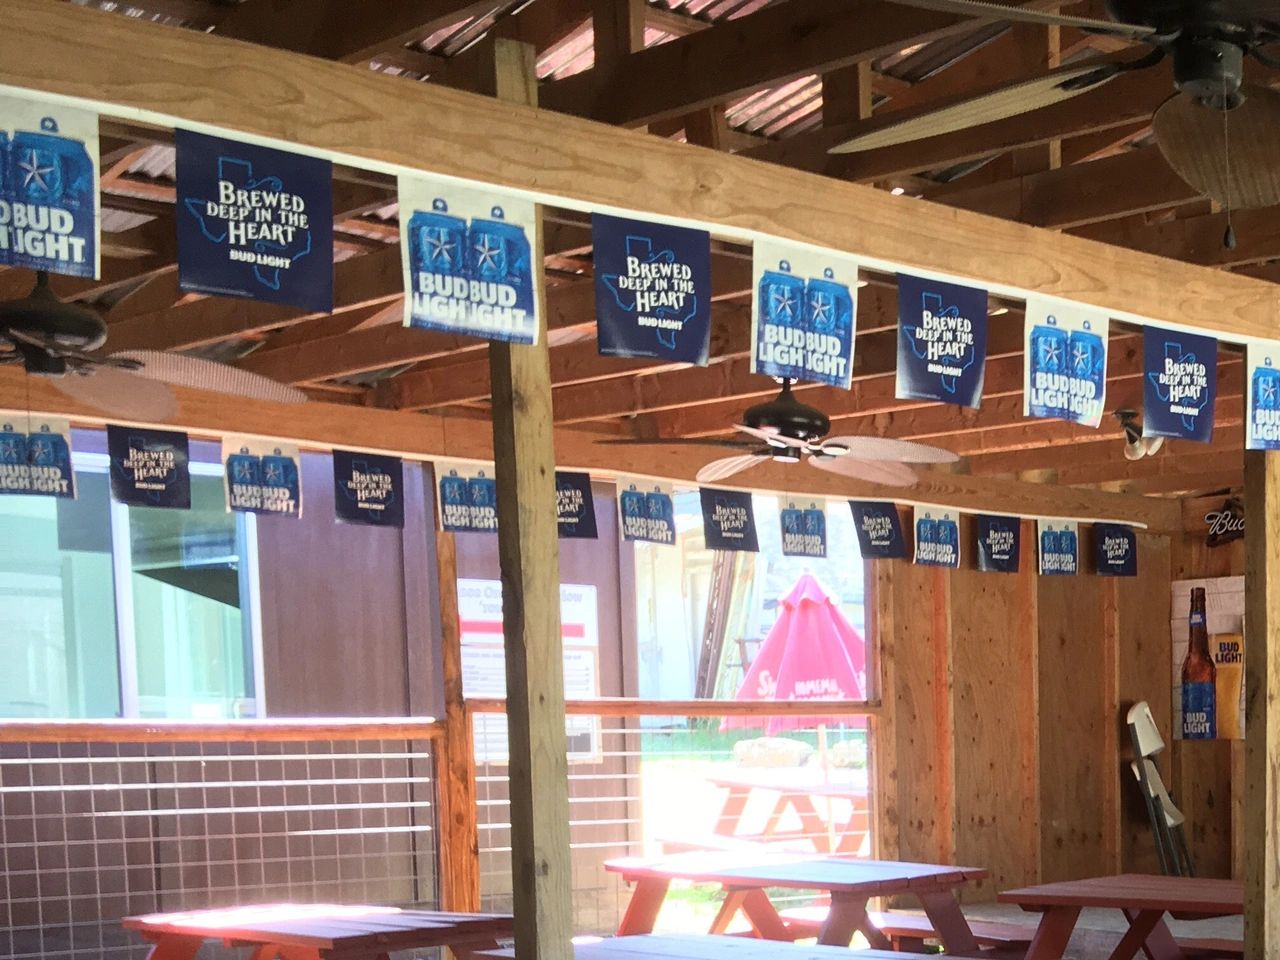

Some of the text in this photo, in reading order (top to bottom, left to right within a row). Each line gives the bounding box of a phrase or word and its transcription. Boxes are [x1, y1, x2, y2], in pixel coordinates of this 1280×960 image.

[218, 179, 305, 213] BREWED
[12, 202, 74, 235] BUD
[207, 201, 309, 229] DEEP IN THE
[228, 220, 297, 246] HEART
[230, 248, 291, 269] BUD LIGHT
[627, 256, 691, 280] BREWED
[419, 271, 468, 299] BUD
[470, 280, 516, 307] BUD
[619, 275, 695, 294] DEEP IN THE
[636, 290, 686, 312] HEART
[923, 310, 971, 333] BREWED
[765, 324, 805, 348] BUD
[806, 332, 841, 356] BUD
[916, 327, 974, 345] DEEP IN THE
[928, 341, 966, 360] HEART
[1165, 358, 1206, 377] BREWED
[1036, 372, 1069, 391] BUD
[1070, 378, 1095, 399] BUD
[1169, 385, 1201, 402] HEART
[129, 447, 173, 461] BREWED
[134, 467, 169, 480] HEART
[352, 470, 391, 483] BREWED
[233, 485, 261, 497] BUD
[262, 487, 290, 500] BUD
[357, 489, 387, 501] HEART
[1219, 642, 1239, 653] BUD
[1215, 653, 1243, 664] LIGHT
[1186, 712, 1207, 723] BUD
[1184, 722, 1210, 734] LIGHT
